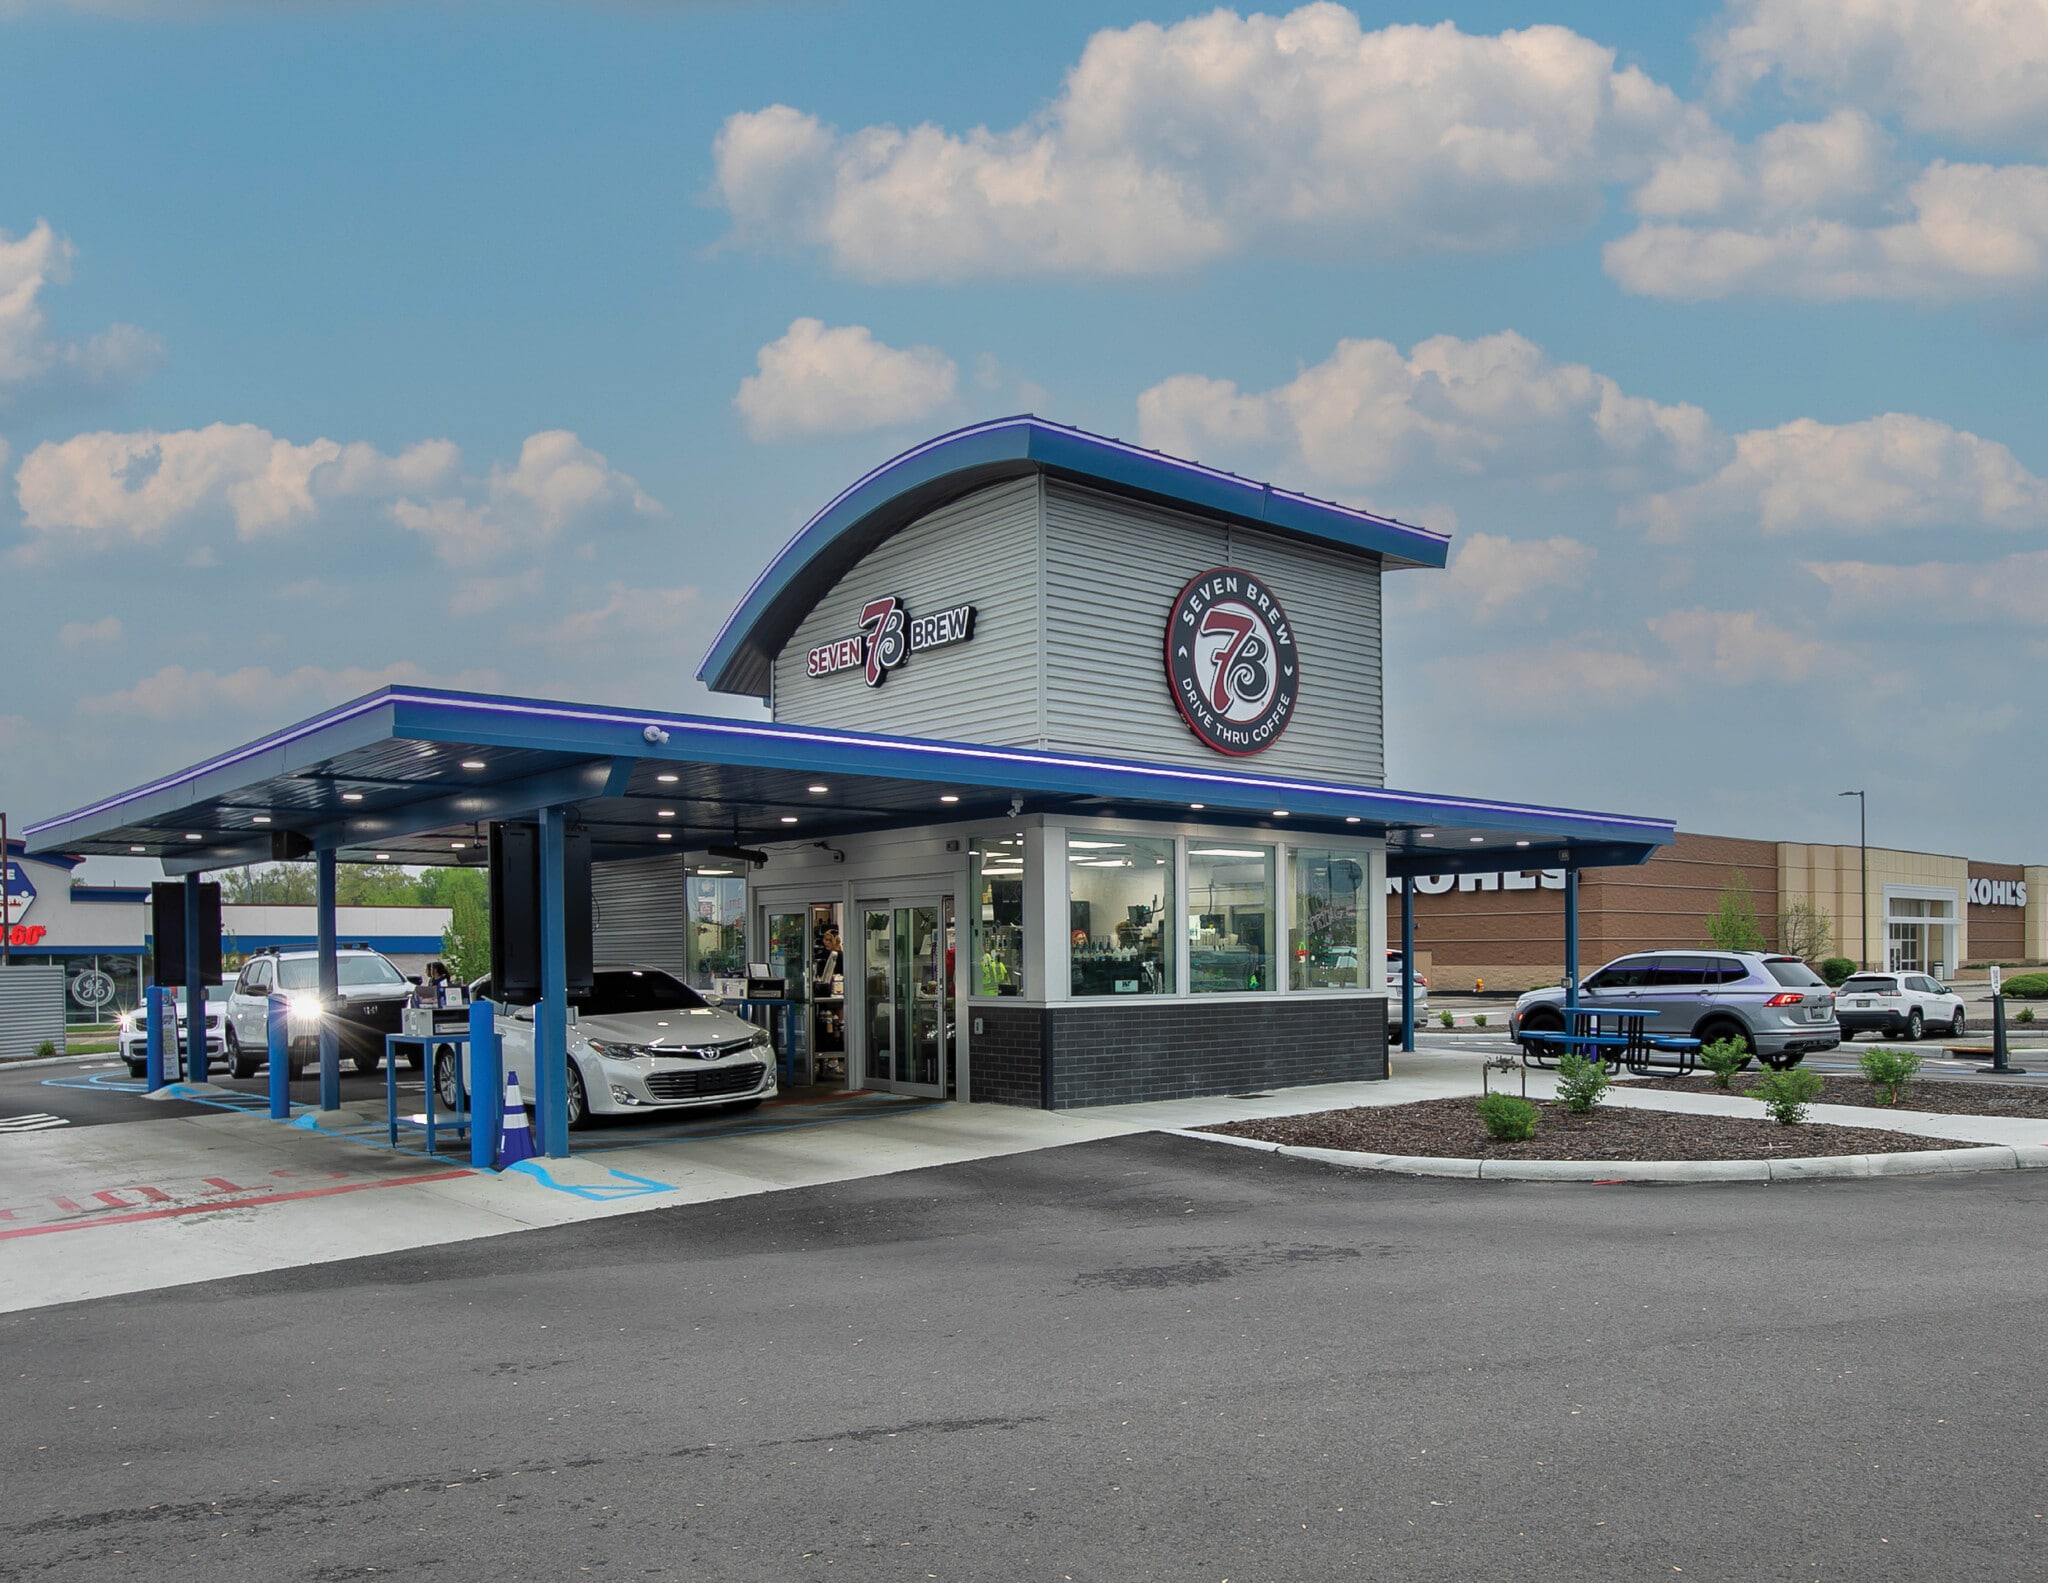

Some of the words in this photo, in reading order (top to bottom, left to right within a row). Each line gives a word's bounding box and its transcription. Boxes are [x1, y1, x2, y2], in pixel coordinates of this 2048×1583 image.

[807, 637, 862, 677] SEVEN
[911, 605, 970, 650] BREW
[1182, 577, 1238, 627] SEVEN
[1246, 583, 1291, 646] BREW
[1182, 677, 1213, 729] DRIVE
[1215, 723, 1250, 745] THRU
[1252, 692, 1291, 742] COFFEE
[1966, 878, 2027, 907] KOHL'S
